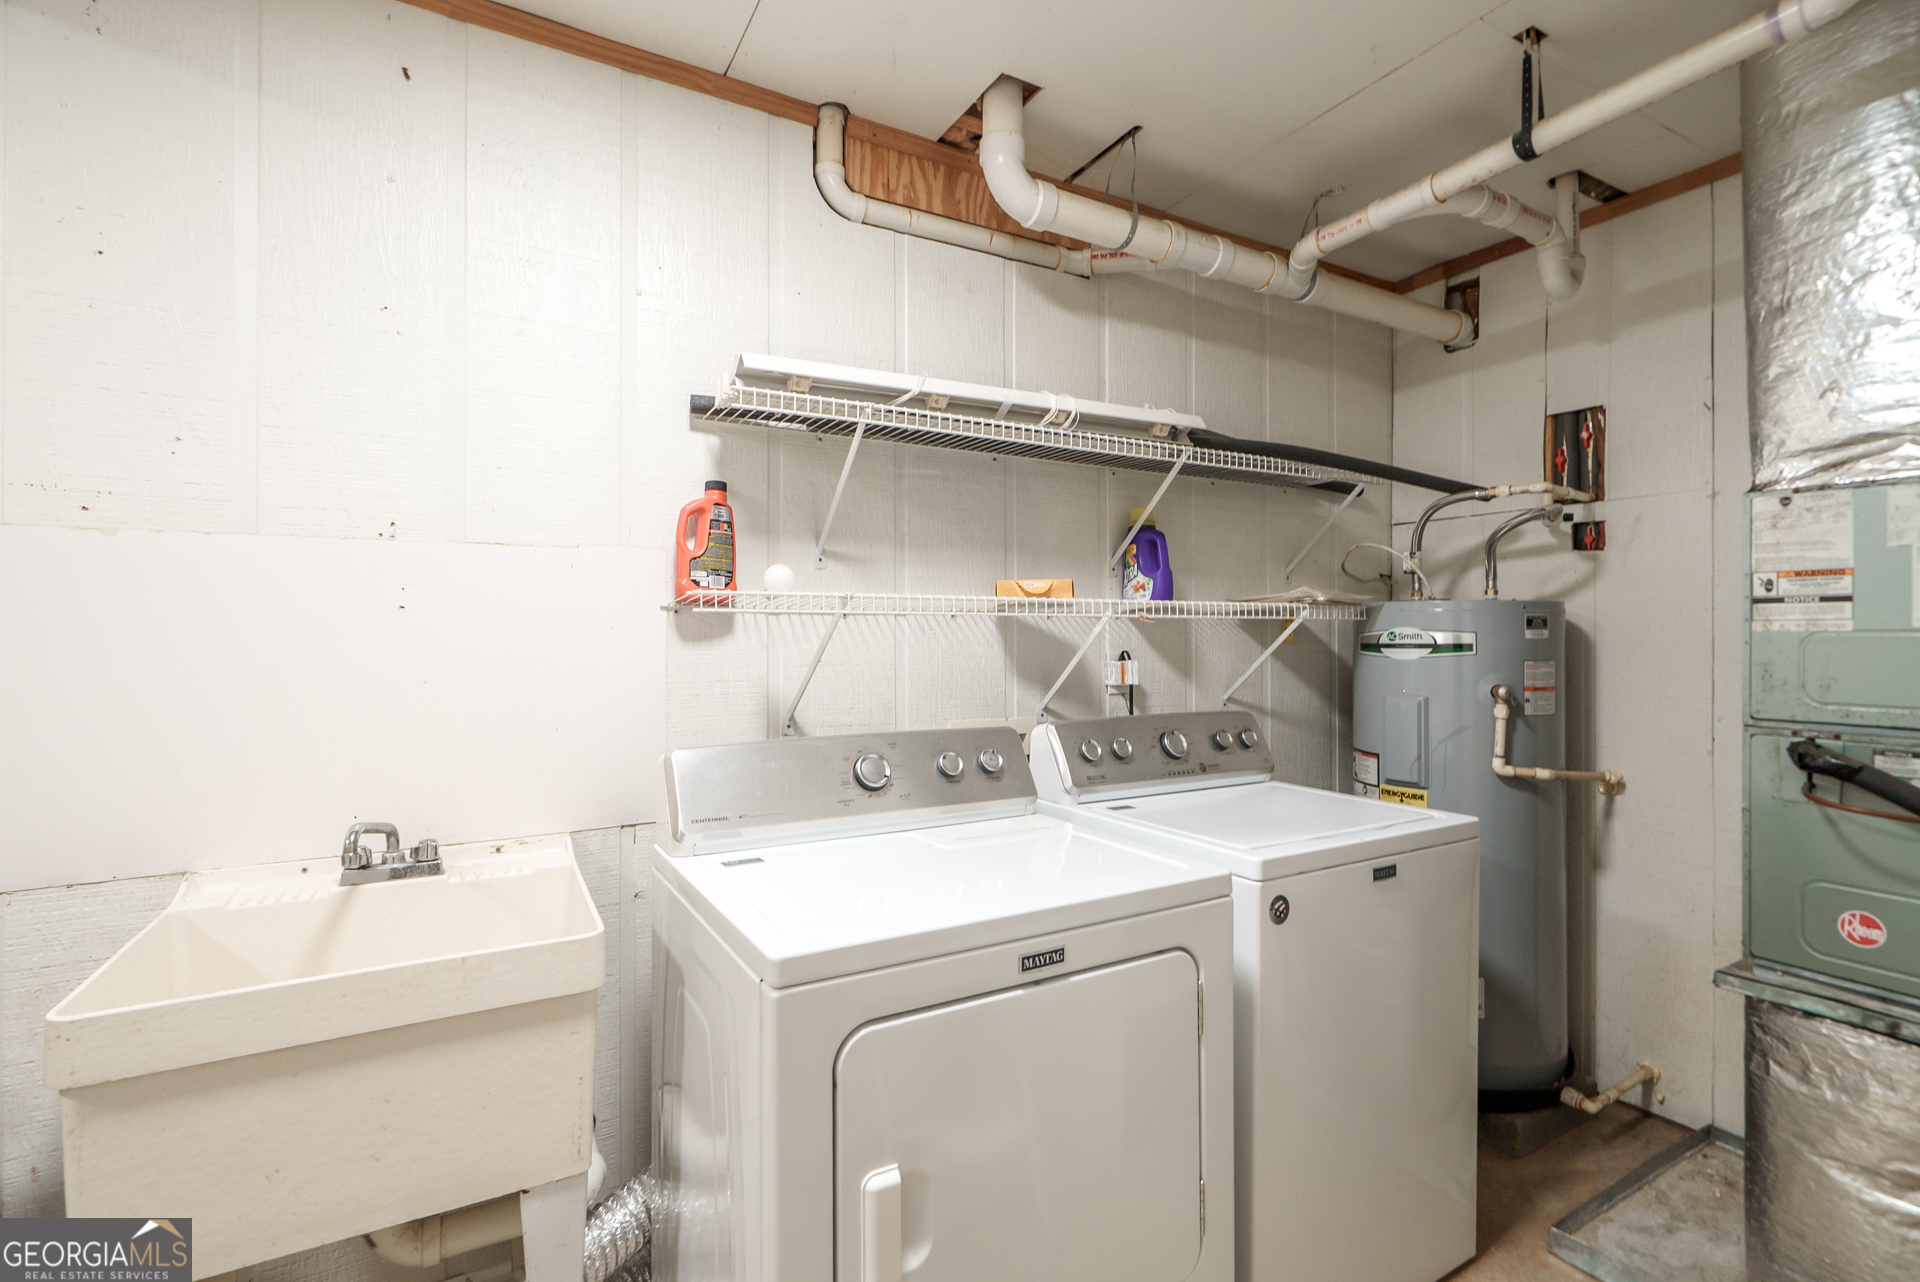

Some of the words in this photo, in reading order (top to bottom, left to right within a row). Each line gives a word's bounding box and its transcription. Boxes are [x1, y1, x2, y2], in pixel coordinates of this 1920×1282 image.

[1398, 632, 1423, 640] Smith
[690, 816, 730, 825] CENTENNIAL
[1374, 866, 1396, 879] MAYTAG
[1843, 912, 1886, 943] Rheem
[1023, 950, 1063, 970] MAYTAG
